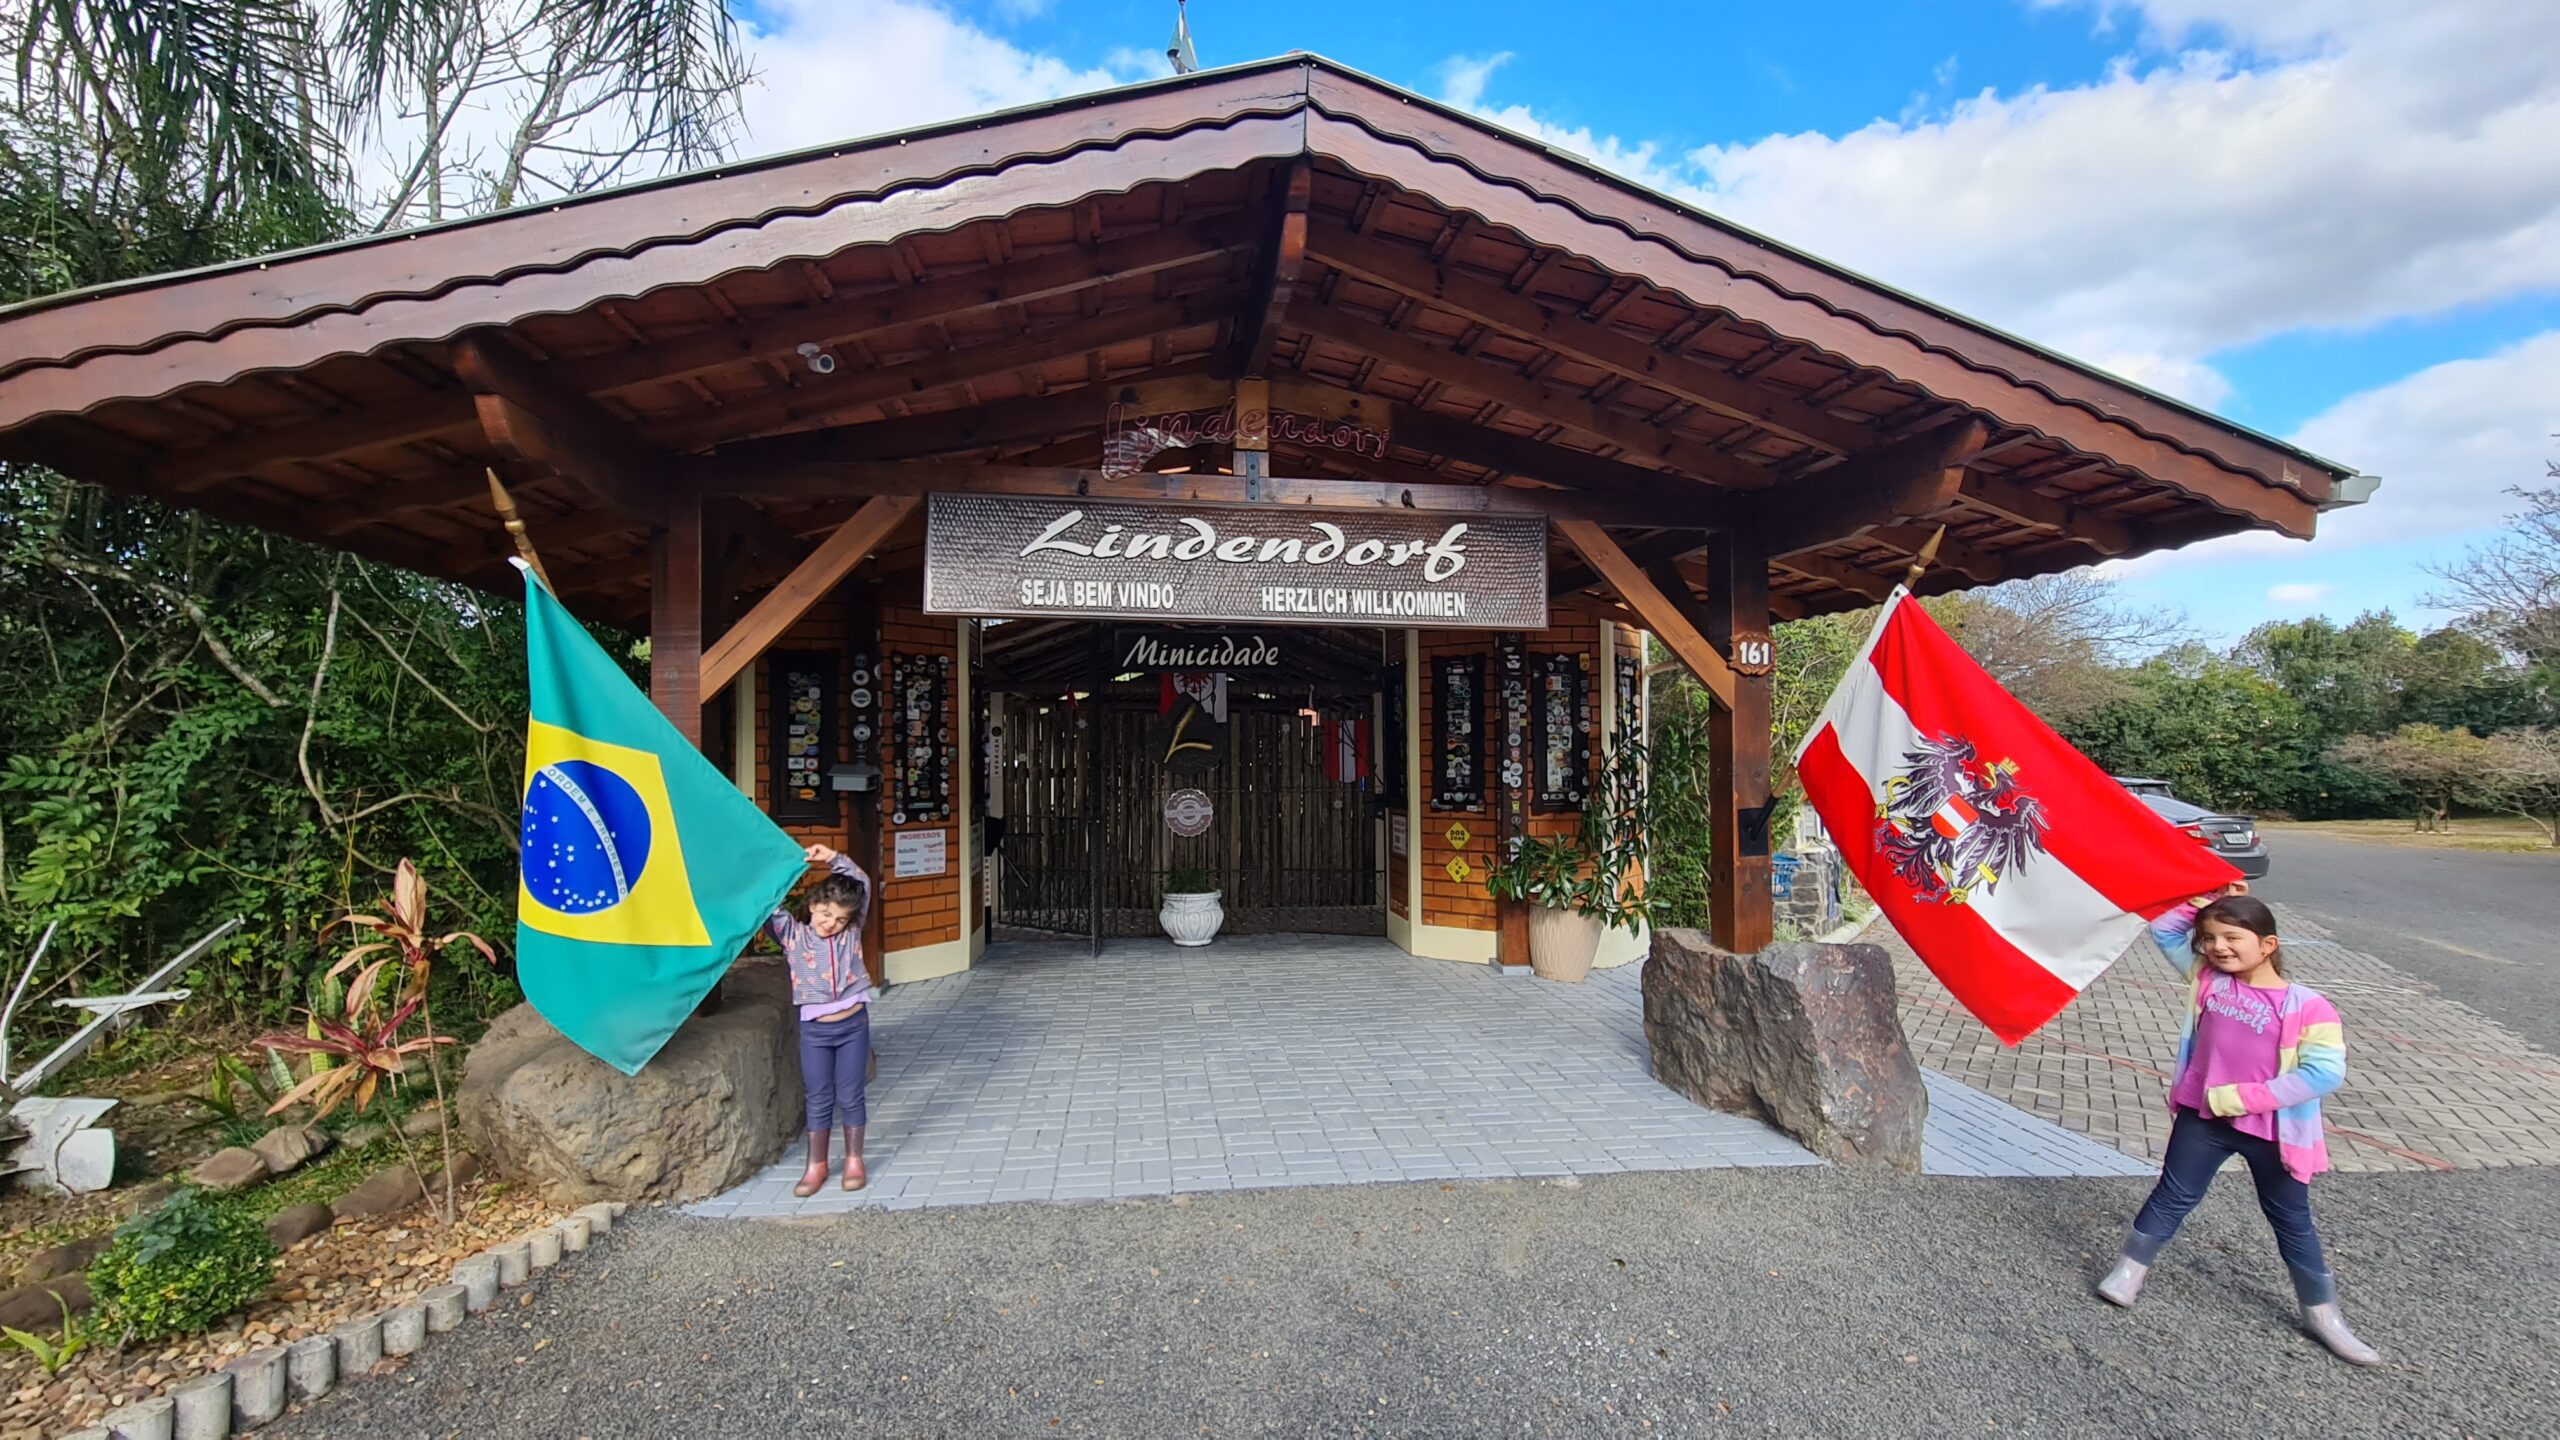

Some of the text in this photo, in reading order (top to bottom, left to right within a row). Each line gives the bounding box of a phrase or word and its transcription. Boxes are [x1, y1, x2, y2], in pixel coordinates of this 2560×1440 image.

[1020, 510, 1468, 582] Lindendorf
[1021, 578, 1175, 609] SEJA BEM VINDO
[1261, 586, 1467, 617] HERZLICH WILLKOMMEN
[1122, 634, 1280, 668] Minicidade
[1739, 641, 1769, 666] 161
[547, 768, 587, 805] ORDEM
[586, 807, 595, 816] E
[2206, 996, 2272, 1035] yourself
[2237, 994, 2274, 1016] TIME
